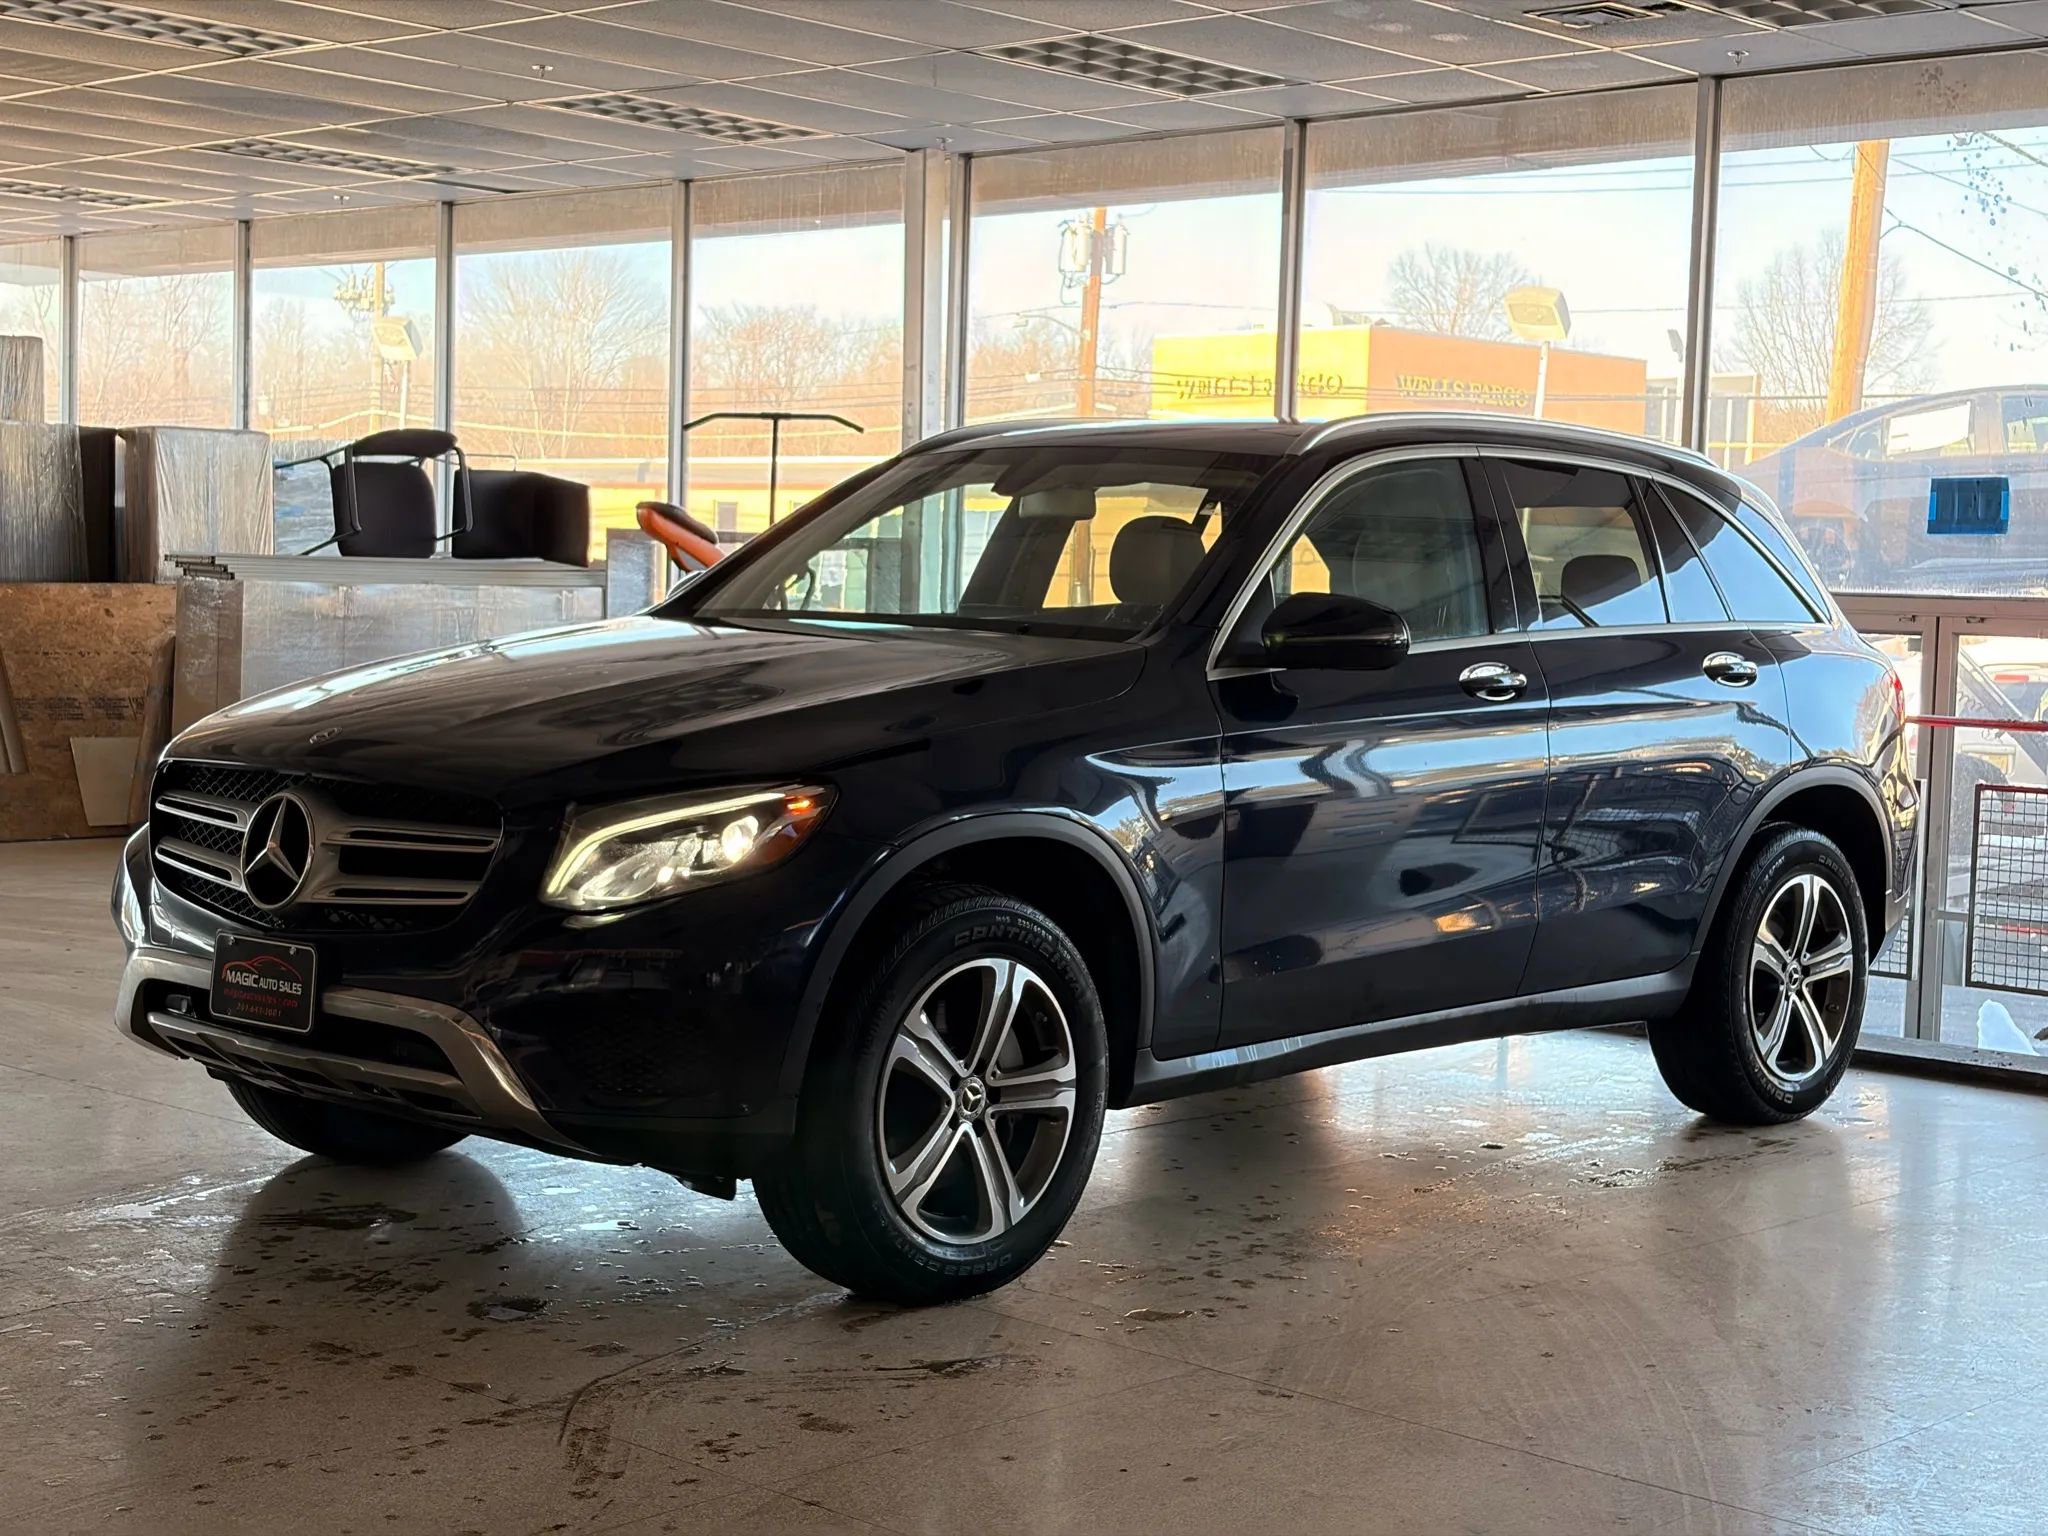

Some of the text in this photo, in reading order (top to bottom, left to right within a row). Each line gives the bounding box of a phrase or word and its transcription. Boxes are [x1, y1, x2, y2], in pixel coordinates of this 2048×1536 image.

[1397, 374, 1529, 408] WELLS FARGO
[954, 923, 1084, 1001] CONTINENTA
[225, 969, 302, 995] MAGIC AUTO SALES
